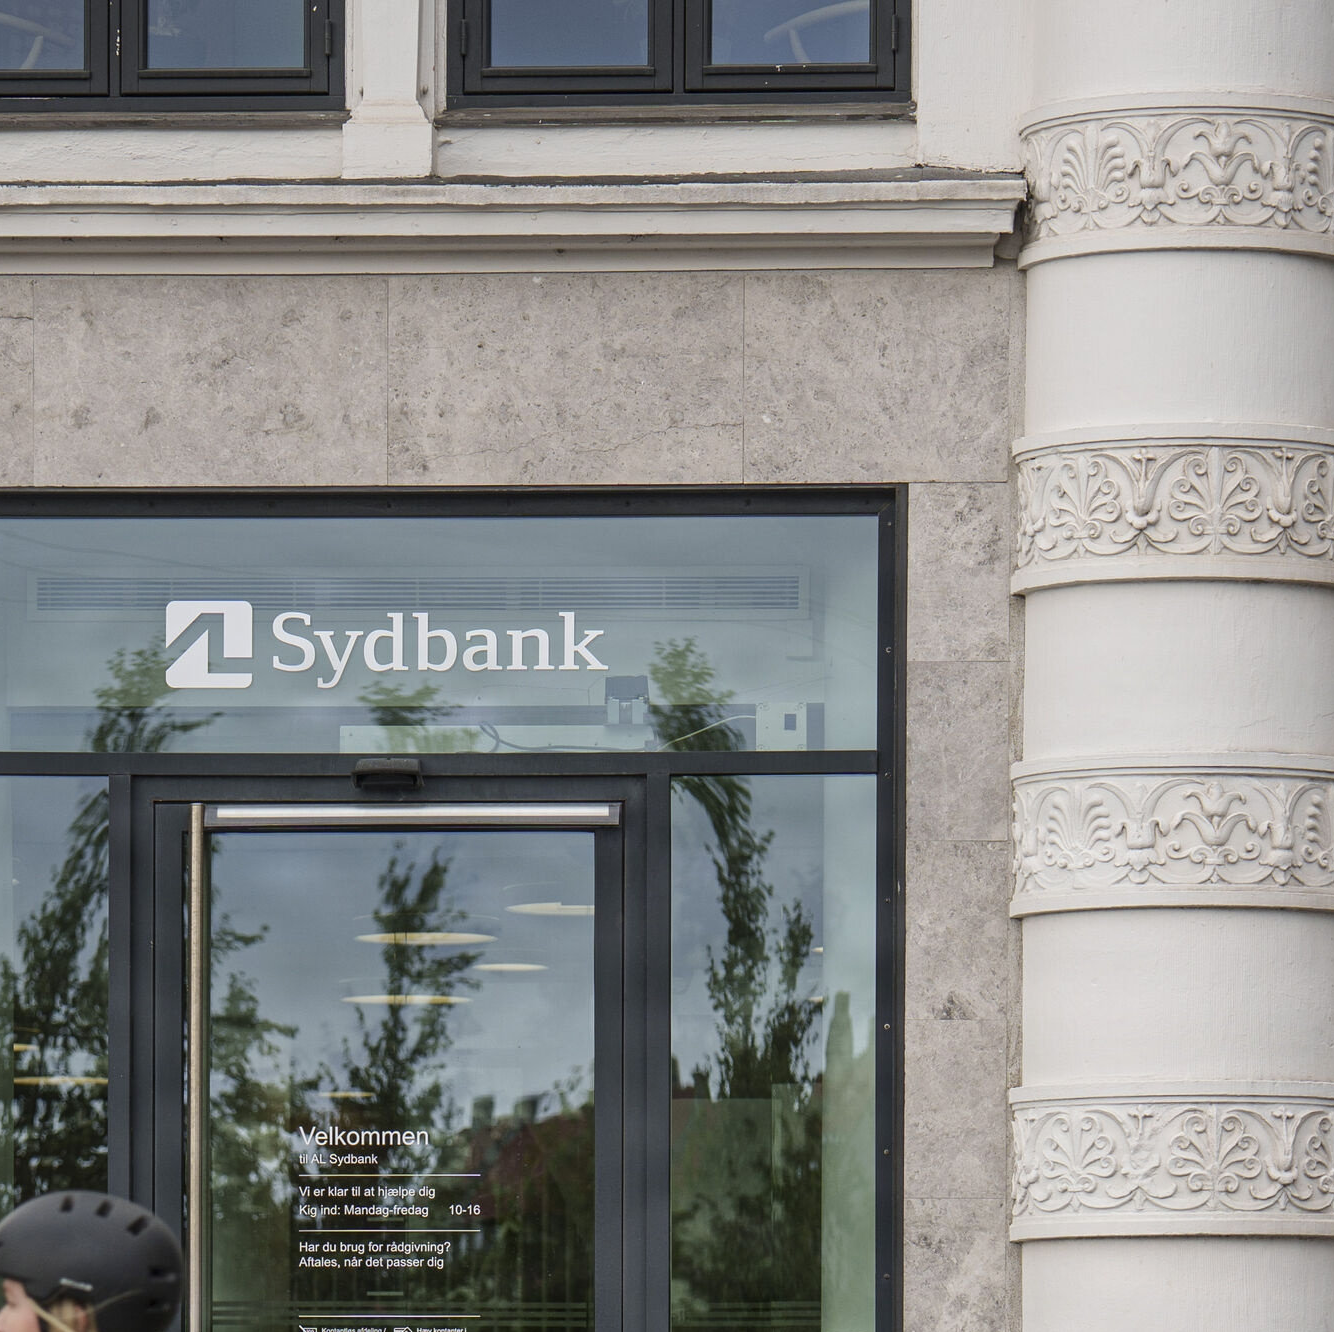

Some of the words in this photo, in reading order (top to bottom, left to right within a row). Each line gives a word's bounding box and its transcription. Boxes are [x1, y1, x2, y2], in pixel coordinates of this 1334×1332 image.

[272, 611, 609, 689] Sydbank
[298, 1126, 429, 1146] Velkommen
[298, 1154, 308, 1164] til
[311, 1154, 326, 1164] AL
[329, 1154, 378, 1167] Sydbank
[298, 1187, 310, 1197] Vi
[313, 1189, 326, 1197] er
[328, 1187, 348, 1197] klar
[351, 1187, 361, 1197] til
[364, 1187, 375, 1197] at
[377, 1187, 415, 1199] hjælpe
[419, 1187, 436, 1199] dig
[299, 1205, 317, 1218] Kig
[320, 1205, 341, 1215] ind:
[344, 1205, 429, 1218] Mandag-fredag
[449, 1205, 481, 1215] 10-16
[299, 1242, 320, 1252] Har
[323, 1242, 337, 1252] du
[339, 1242, 365, 1255] brug
[368, 1242, 384, 1252] for
[386, 1241, 451, 1255] rådgivning?
[298, 1257, 341, 1269] Aftales,
[344, 1256, 363, 1268] når
[365, 1257, 383, 1268] det
[386, 1259, 424, 1270] passer
[427, 1257, 444, 1270] dig
